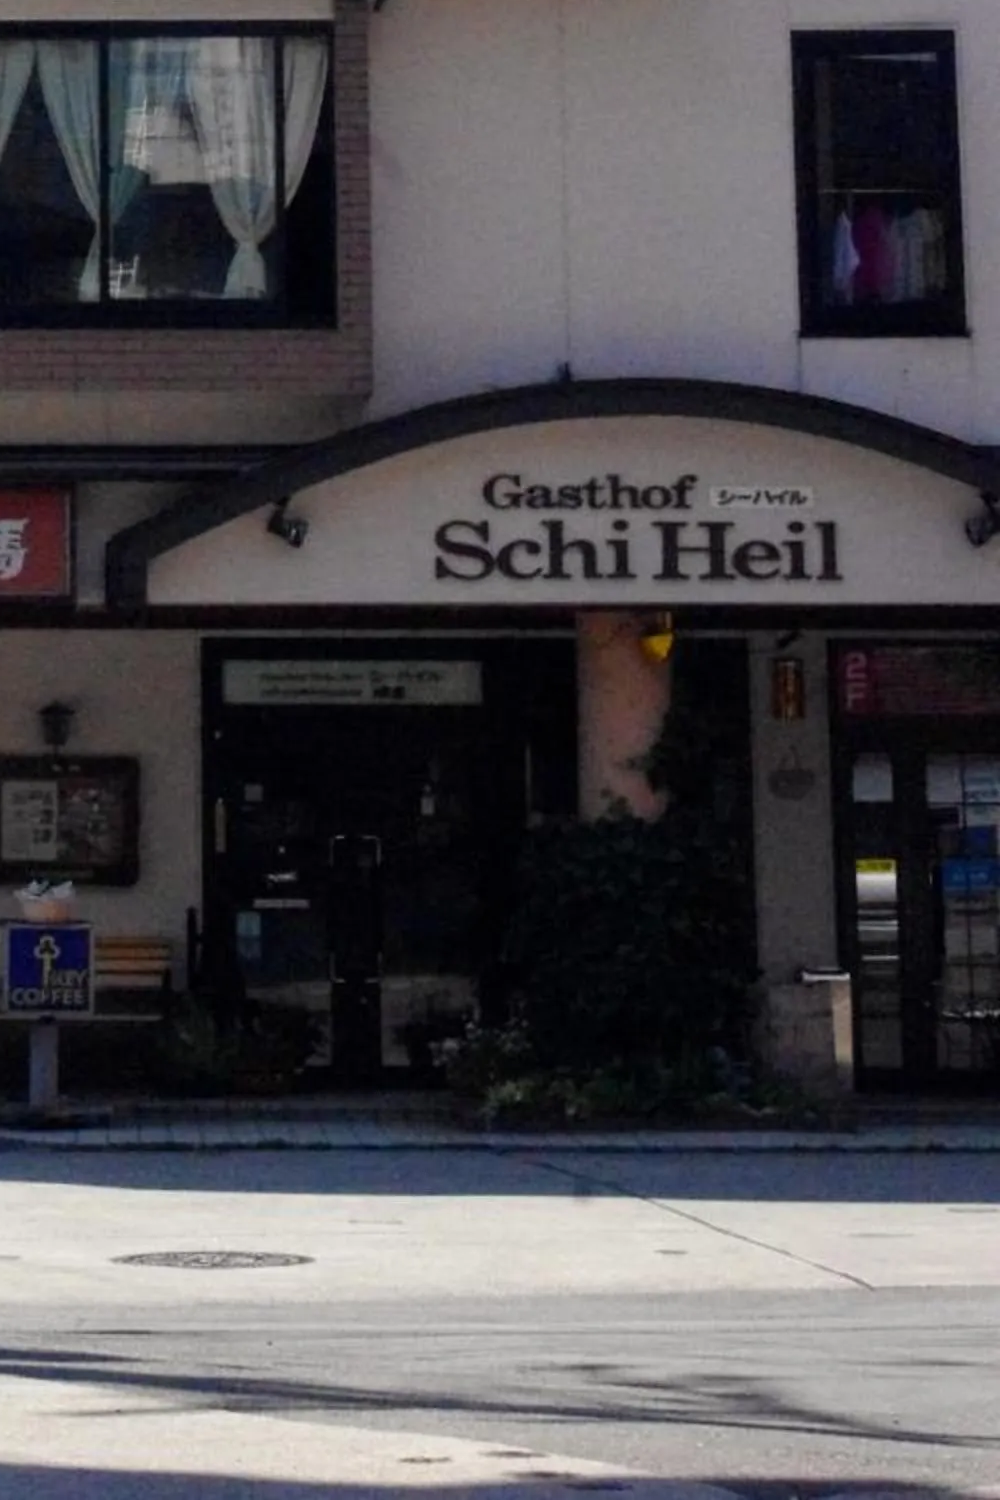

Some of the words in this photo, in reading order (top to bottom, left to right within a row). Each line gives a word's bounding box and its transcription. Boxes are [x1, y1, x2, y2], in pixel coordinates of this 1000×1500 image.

[483, 474, 697, 510] Gasthof
[434, 519, 637, 582] Schi
[652, 520, 843, 581] Heil
